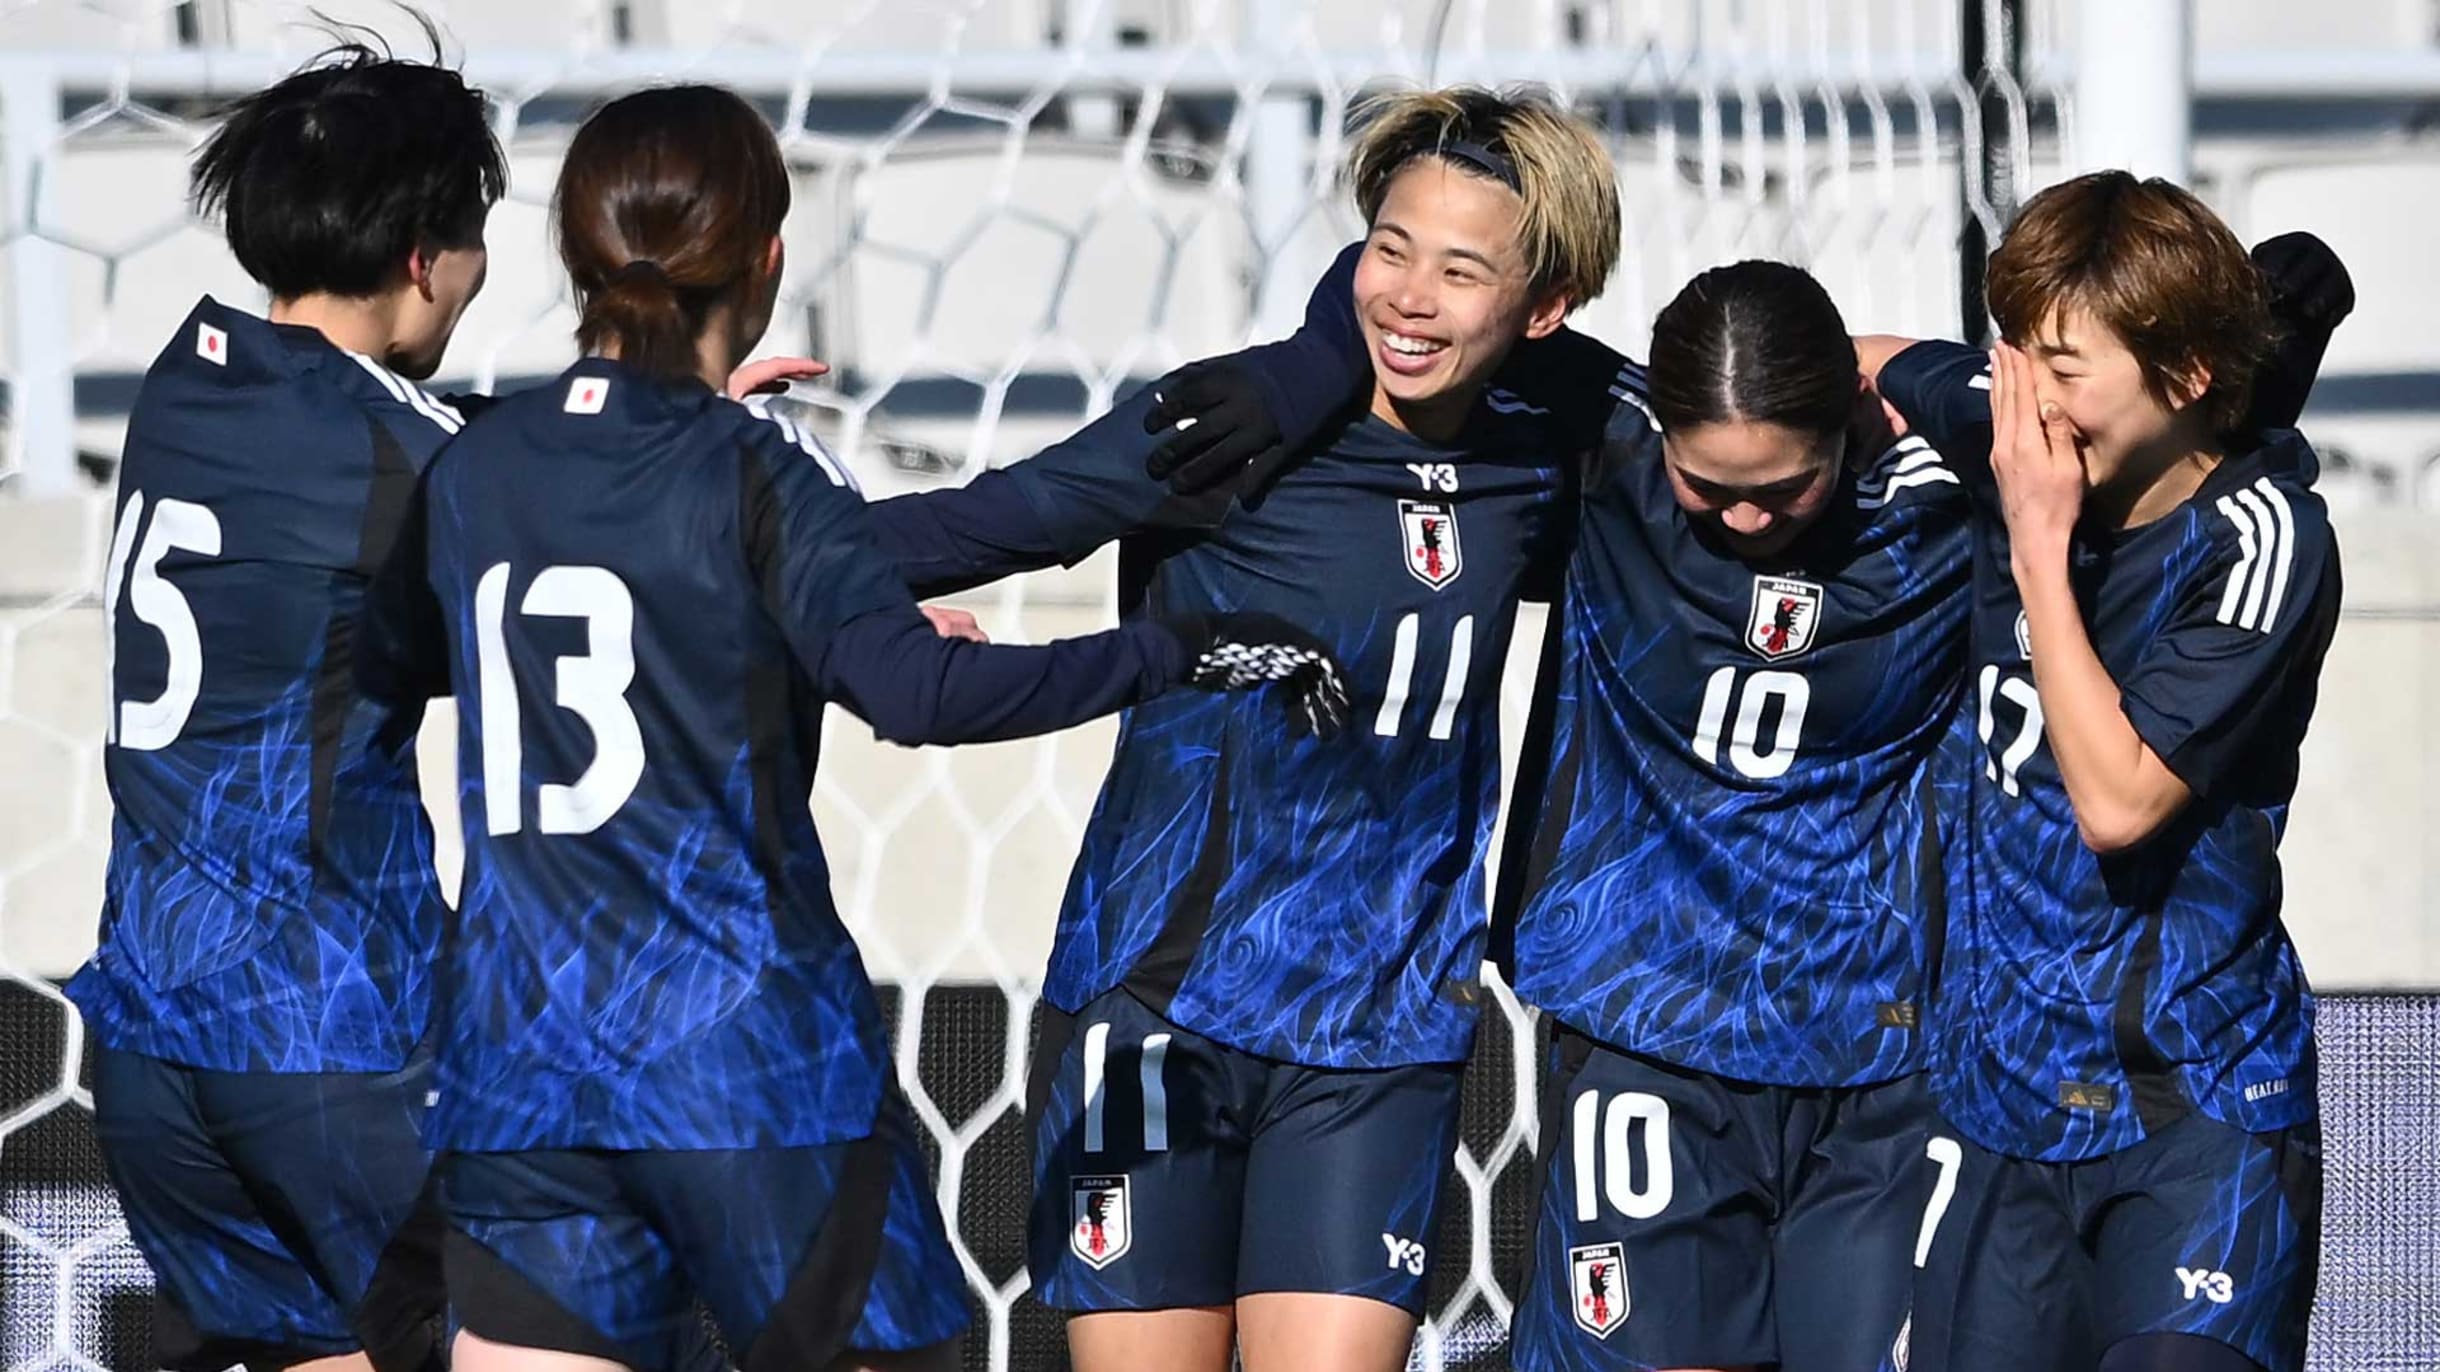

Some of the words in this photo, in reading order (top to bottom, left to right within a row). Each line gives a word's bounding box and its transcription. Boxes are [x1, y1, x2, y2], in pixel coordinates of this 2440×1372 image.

[104, 488, 223, 752] 15
[1771, 582, 1807, 595] JAPAN
[475, 561, 646, 837] 13
[1374, 612, 1474, 740] 11
[1692, 666, 1810, 779] 10
[1977, 664, 2045, 798] 17
[1083, 1021, 1172, 1153] 11
[1573, 1089, 1674, 1221] 10
